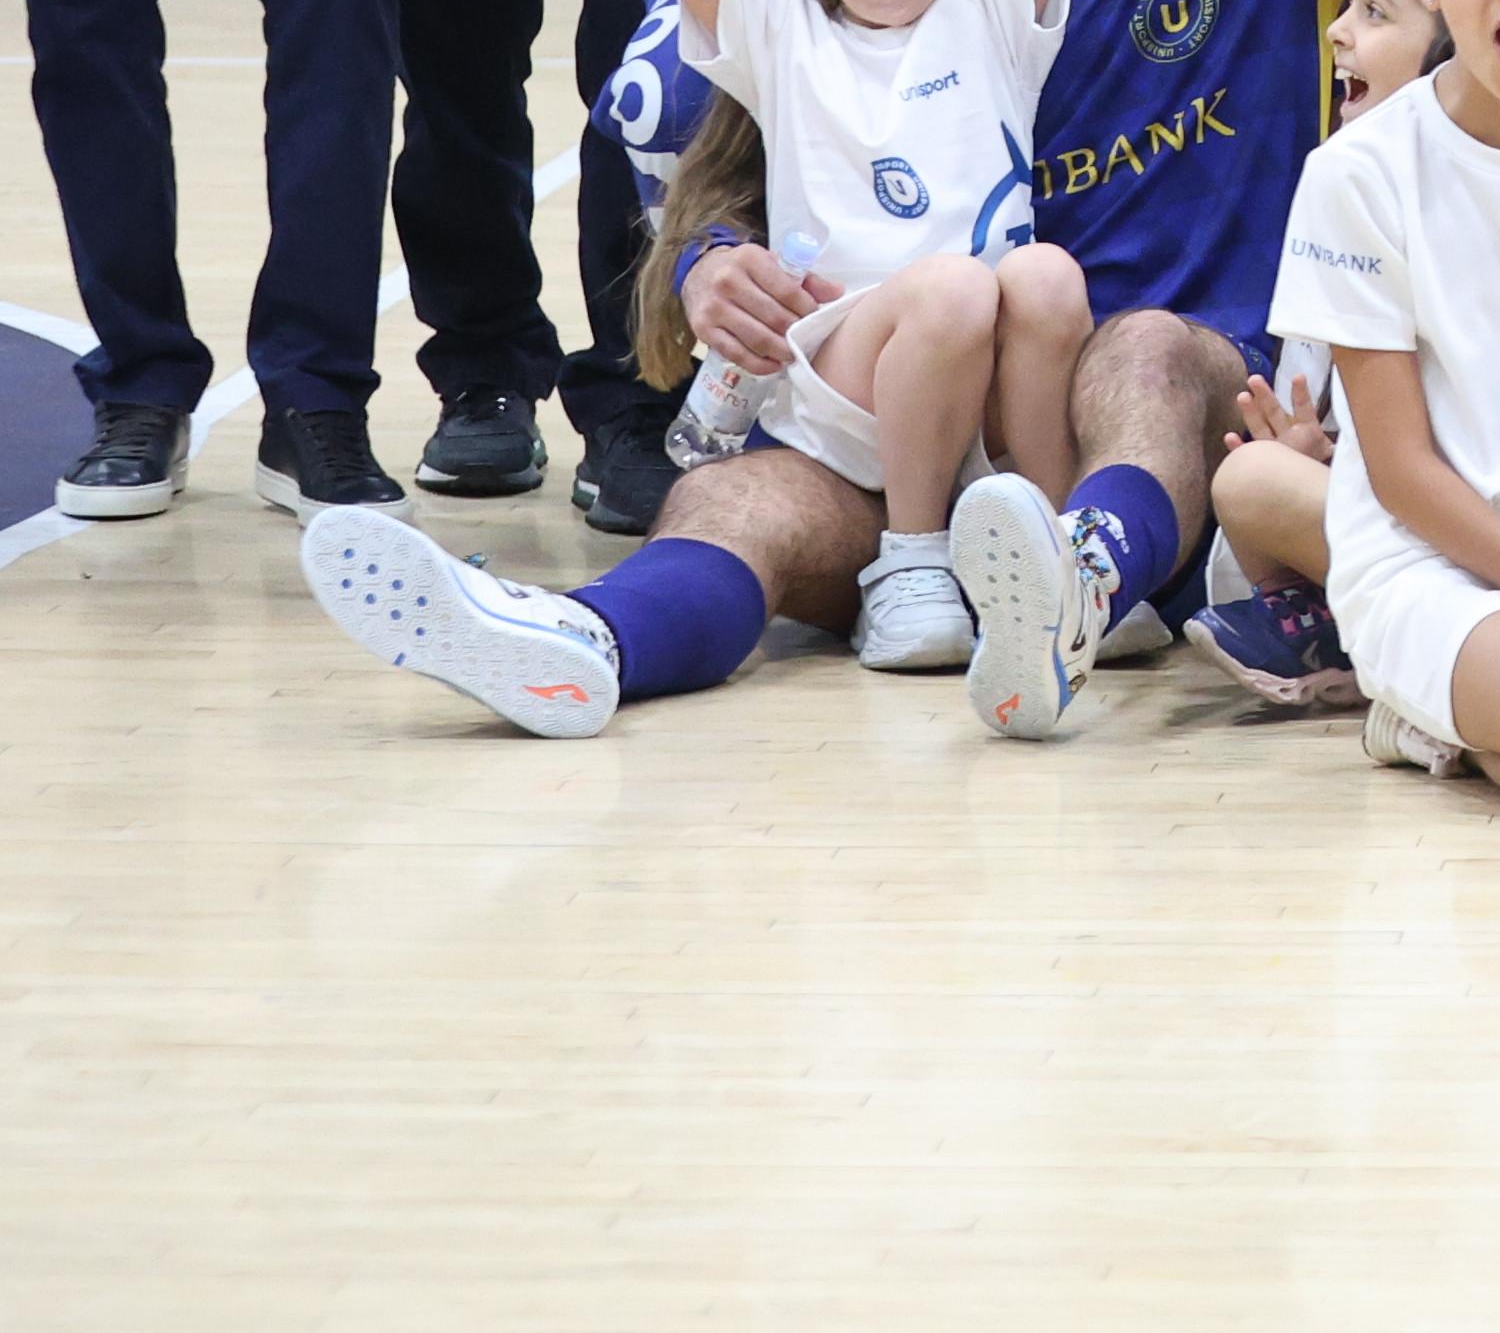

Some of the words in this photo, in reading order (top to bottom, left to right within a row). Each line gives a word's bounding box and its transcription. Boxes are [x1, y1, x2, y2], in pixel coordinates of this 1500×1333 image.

[1160, 0, 1189, 33] U
[899, 71, 960, 102] unisport
[1034, 88, 1236, 200] IBANK
